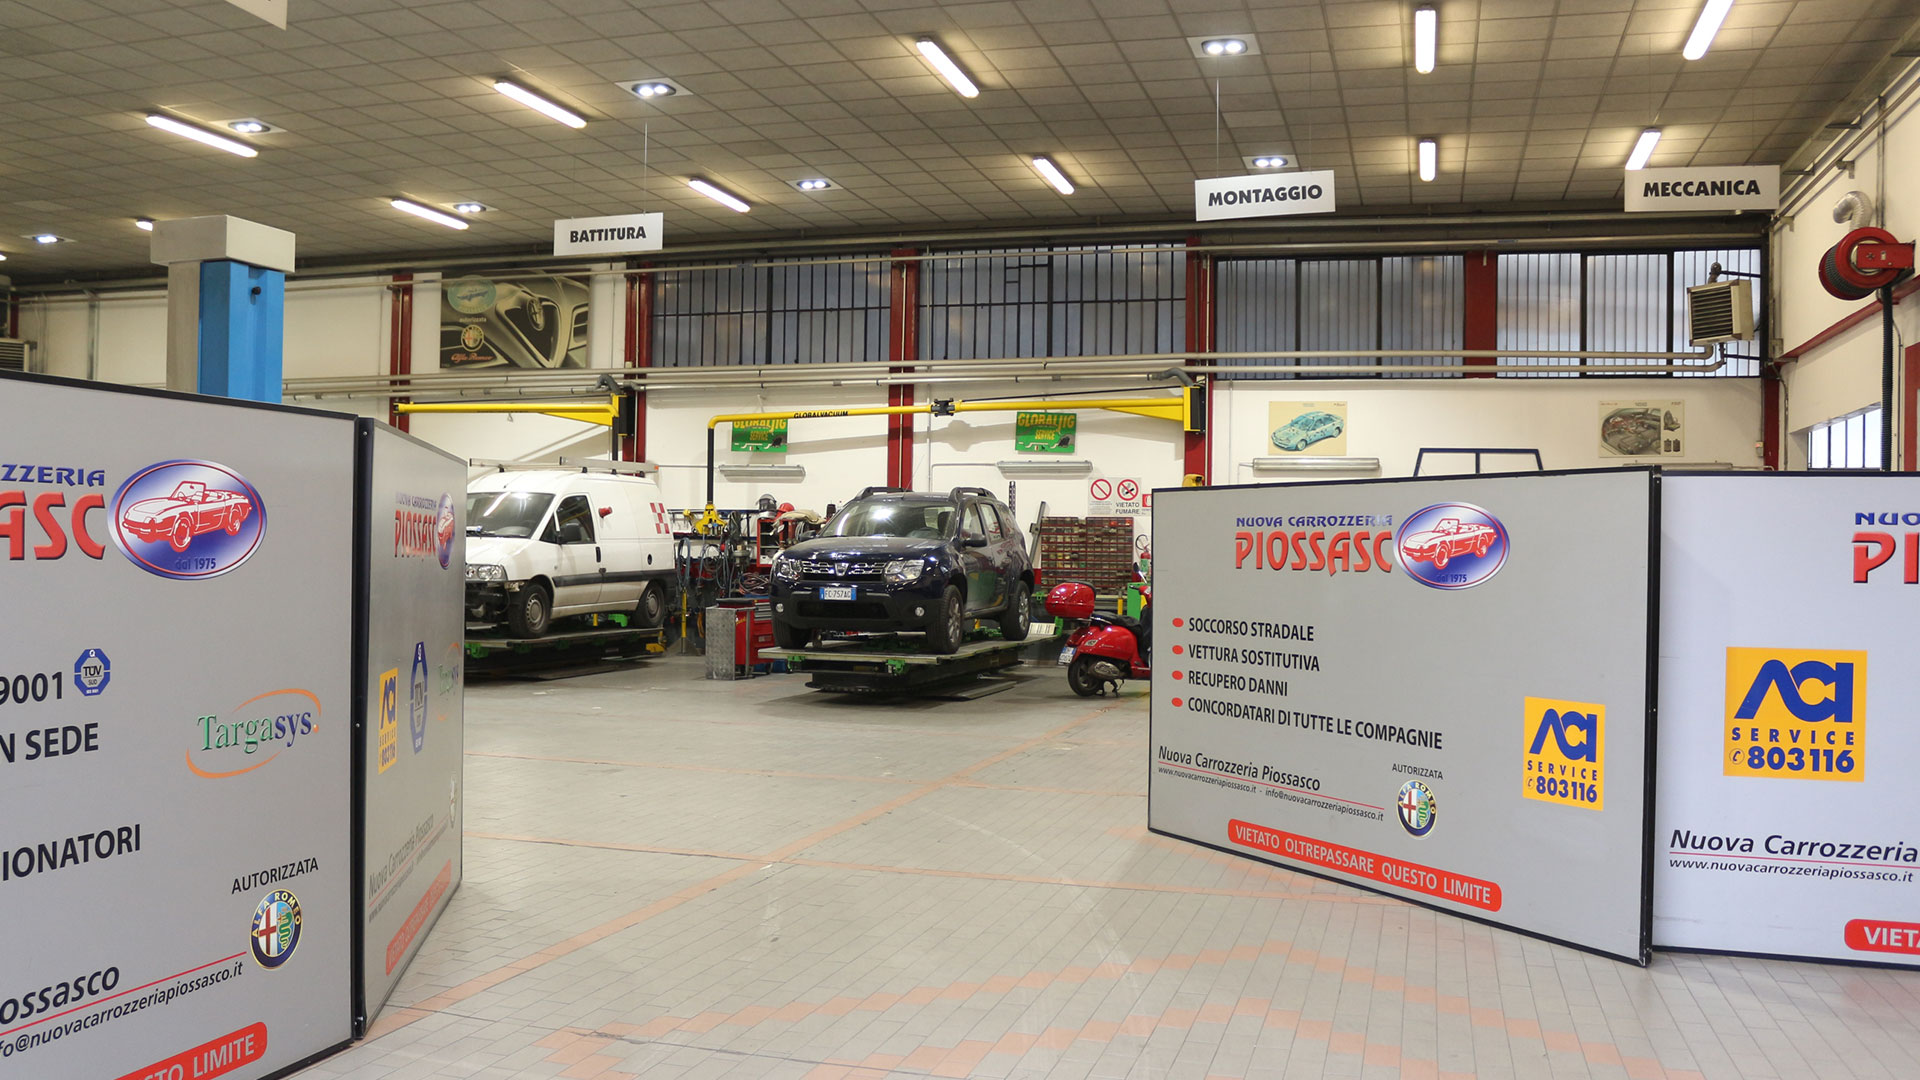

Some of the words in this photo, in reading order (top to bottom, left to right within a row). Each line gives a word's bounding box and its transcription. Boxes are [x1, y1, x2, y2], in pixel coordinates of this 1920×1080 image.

[1208, 184, 1322, 207] MONTAGGIO
[1643, 180, 1761, 197] MECCANICA
[570, 226, 647, 243] BATTITURA
[793, 411, 849, 419] GLOBALVACUUM
[1, 464, 105, 487] ZZERIA
[1236, 516, 1283, 528] NUOVA
[1288, 515, 1392, 528] CARROZZERIA
[175, 558, 191, 570] dal
[194, 558, 216, 570] 1975
[1235, 531, 1393, 576] PIOSSASC
[1451, 574, 1468, 583] 1975
[1189, 617, 1248, 636] SOCCORSO
[1251, 622, 1315, 642] STRADALE
[1188, 644, 1239, 664] VETTURA
[1241, 649, 1320, 672] SOSTITUTIVA
[1188, 670, 1246, 691] RECUPERO
[1249, 677, 1288, 697] DANNI
[1734, 659, 1854, 723] ACI
[1188, 697, 1275, 724] CONCORDATARI
[1278, 710, 1291, 727] DI
[1293, 712, 1334, 733] TUTTE
[1337, 718, 1352, 736] LE
[1355, 721, 1443, 750] COMPAGNIE
[1529, 708, 1598, 763] ACI
[1731, 727, 1855, 745] SERVICE
[25, 722, 99, 760] SEDE
[1159, 745, 1192, 765] Nuova
[1195, 752, 1259, 779] Carrozzeria
[1261, 765, 1321, 792] Piossasco
[1392, 763, 1444, 780] AUTORIZZATA
[1527, 760, 1598, 781] SERVICE
[1747, 746, 1855, 773] 803116
[1158, 767, 1257, 794] www.nuovacarrozzeriapiossasco.it
[1265, 788, 1384, 822] info@nuovacarrozzeriapiossasco.it
[1536, 775, 1598, 803] 803116
[3, 824, 141, 881] IONATORI
[1670, 829, 1755, 853] Nuova
[1764, 835, 1918, 863] Carrozzeria
[231, 857, 319, 895] AUTORIZZATA
[1235, 825, 1280, 849] VIETATO
[1284, 838, 1375, 874] OLTREPASSARE
[1382, 862, 1438, 891] QUESTO
[1443, 876, 1492, 905] LIMITE
[1669, 858, 1914, 883] www.nuovacarrozzeriapiossasco.it
[252, 900, 271, 938] ALFA
[274, 892, 302, 926] ROMEO
[1864, 926, 1920, 948] VIET
[193, 1033, 255, 1079] LIMITE
